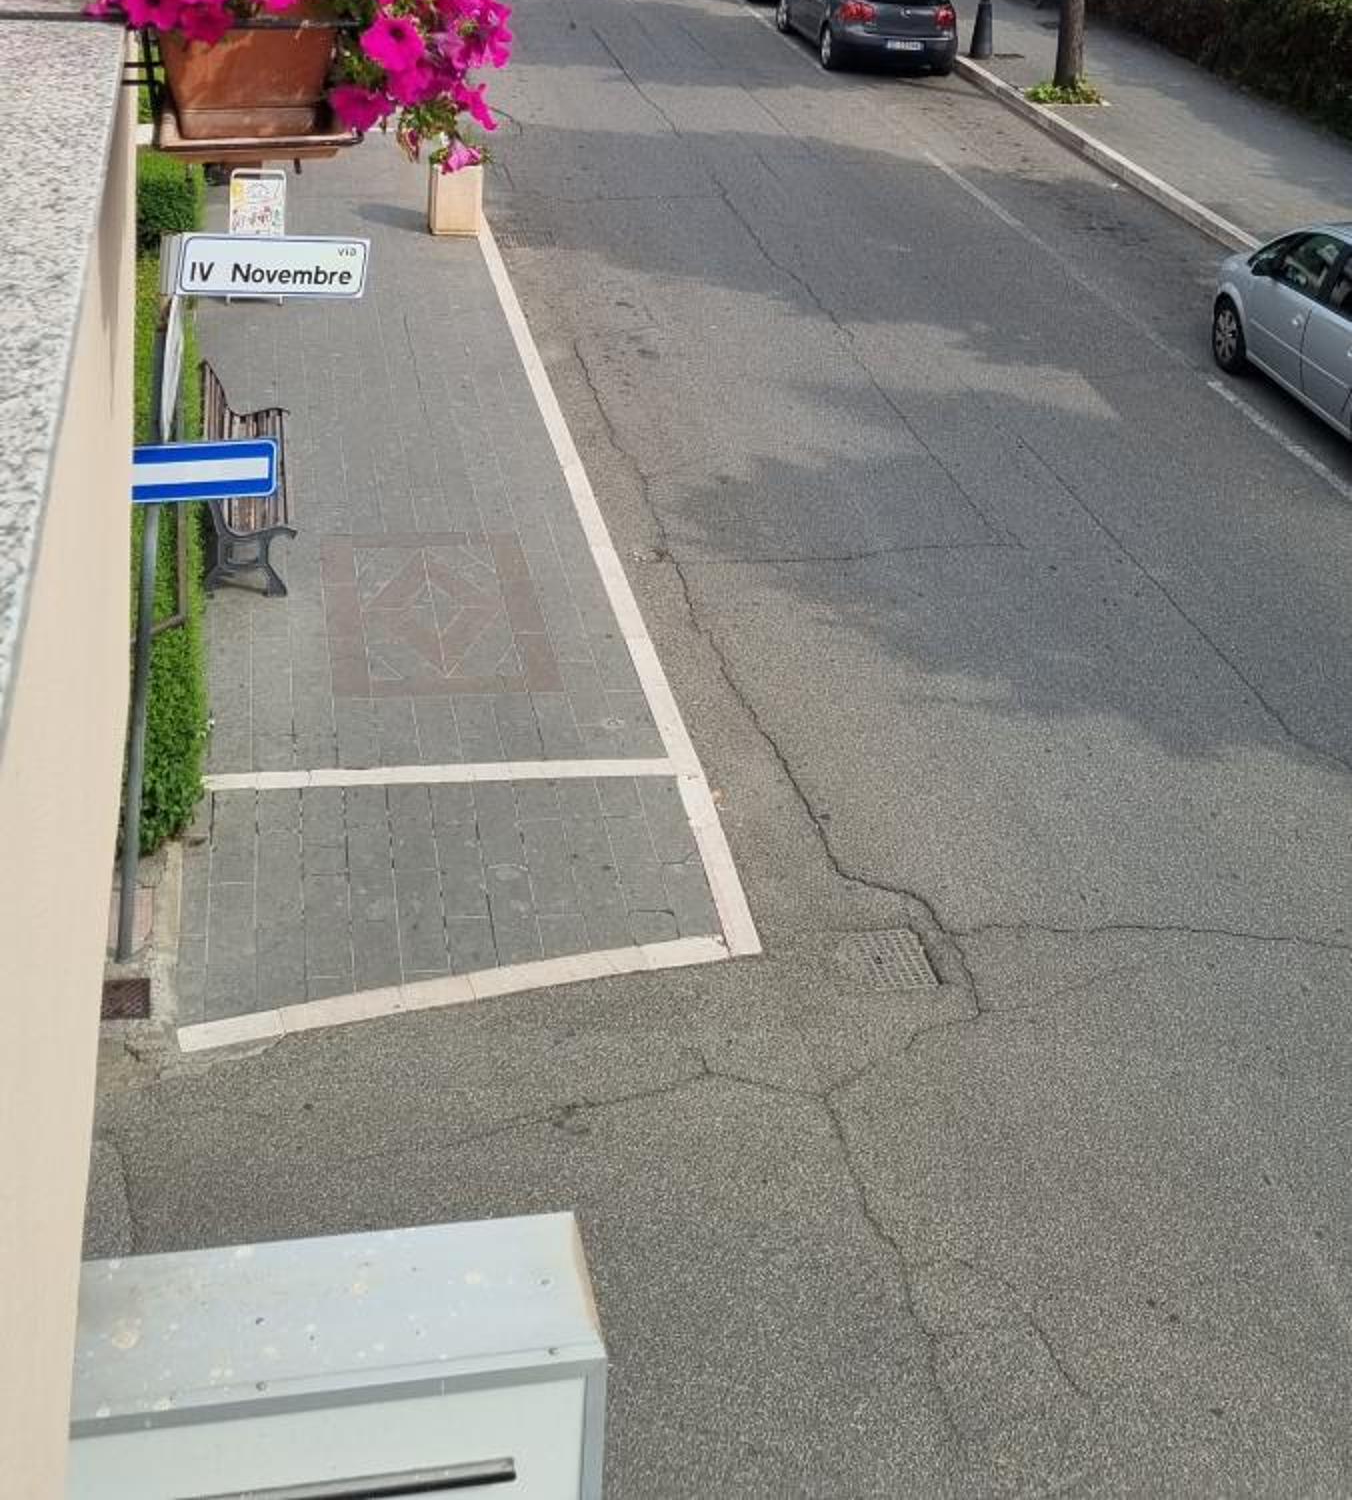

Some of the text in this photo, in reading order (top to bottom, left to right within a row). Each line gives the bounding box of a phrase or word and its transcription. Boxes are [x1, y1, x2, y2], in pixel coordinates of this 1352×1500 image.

[337, 247, 357, 257] via
[190, 261, 352, 285] IV Novembre
